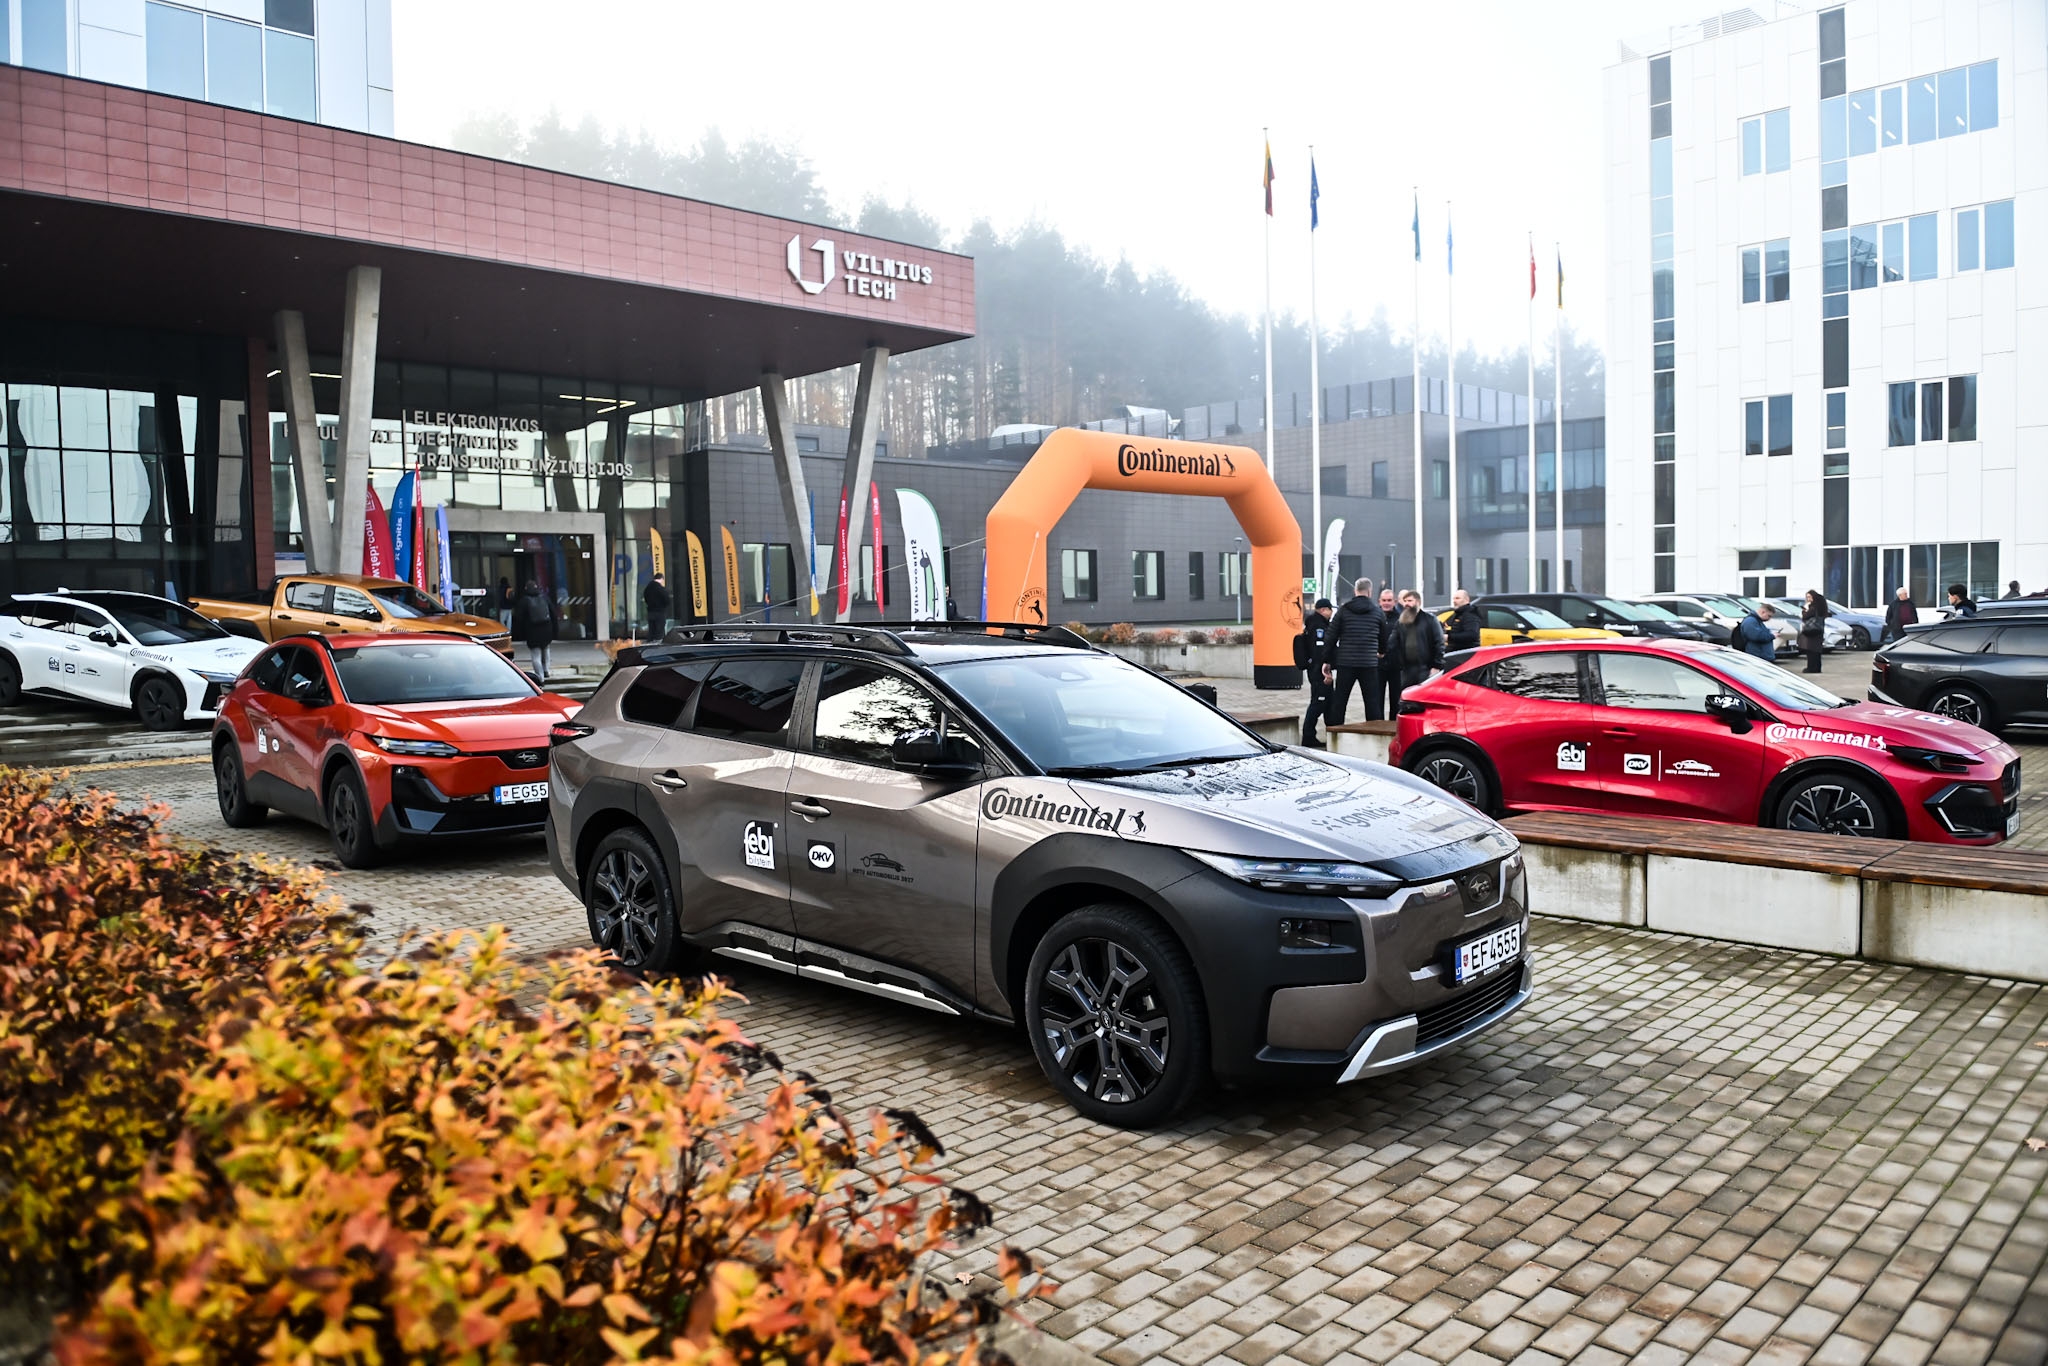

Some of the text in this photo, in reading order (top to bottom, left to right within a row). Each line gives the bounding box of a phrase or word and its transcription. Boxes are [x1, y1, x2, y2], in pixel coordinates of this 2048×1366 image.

[843, 250, 933, 285] VILNIUS
[843, 274, 896, 301] TECH
[414, 410, 539, 433] ELEKTRONIKOS
[414, 431, 519, 451] MECHANIKOS
[416, 452, 633, 477] TRANSPORTO INŽINERIJOS
[1118, 444, 1221, 477] Continental
[395, 517, 403, 551] ignitis
[129, 647, 169, 662] Continental
[1714, 696, 1740, 708] tv3.lt
[1766, 722, 1871, 749] Continental
[1557, 742, 1586, 763] febi
[1627, 760, 1648, 769] DKV
[982, 787, 1126, 832] Continental
[1333, 802, 1400, 828] ignitis
[744, 820, 774, 857] febi
[748, 855, 772, 867] bilstein
[811, 850, 832, 863] DKV
[1471, 928, 1517, 971] EF4555
